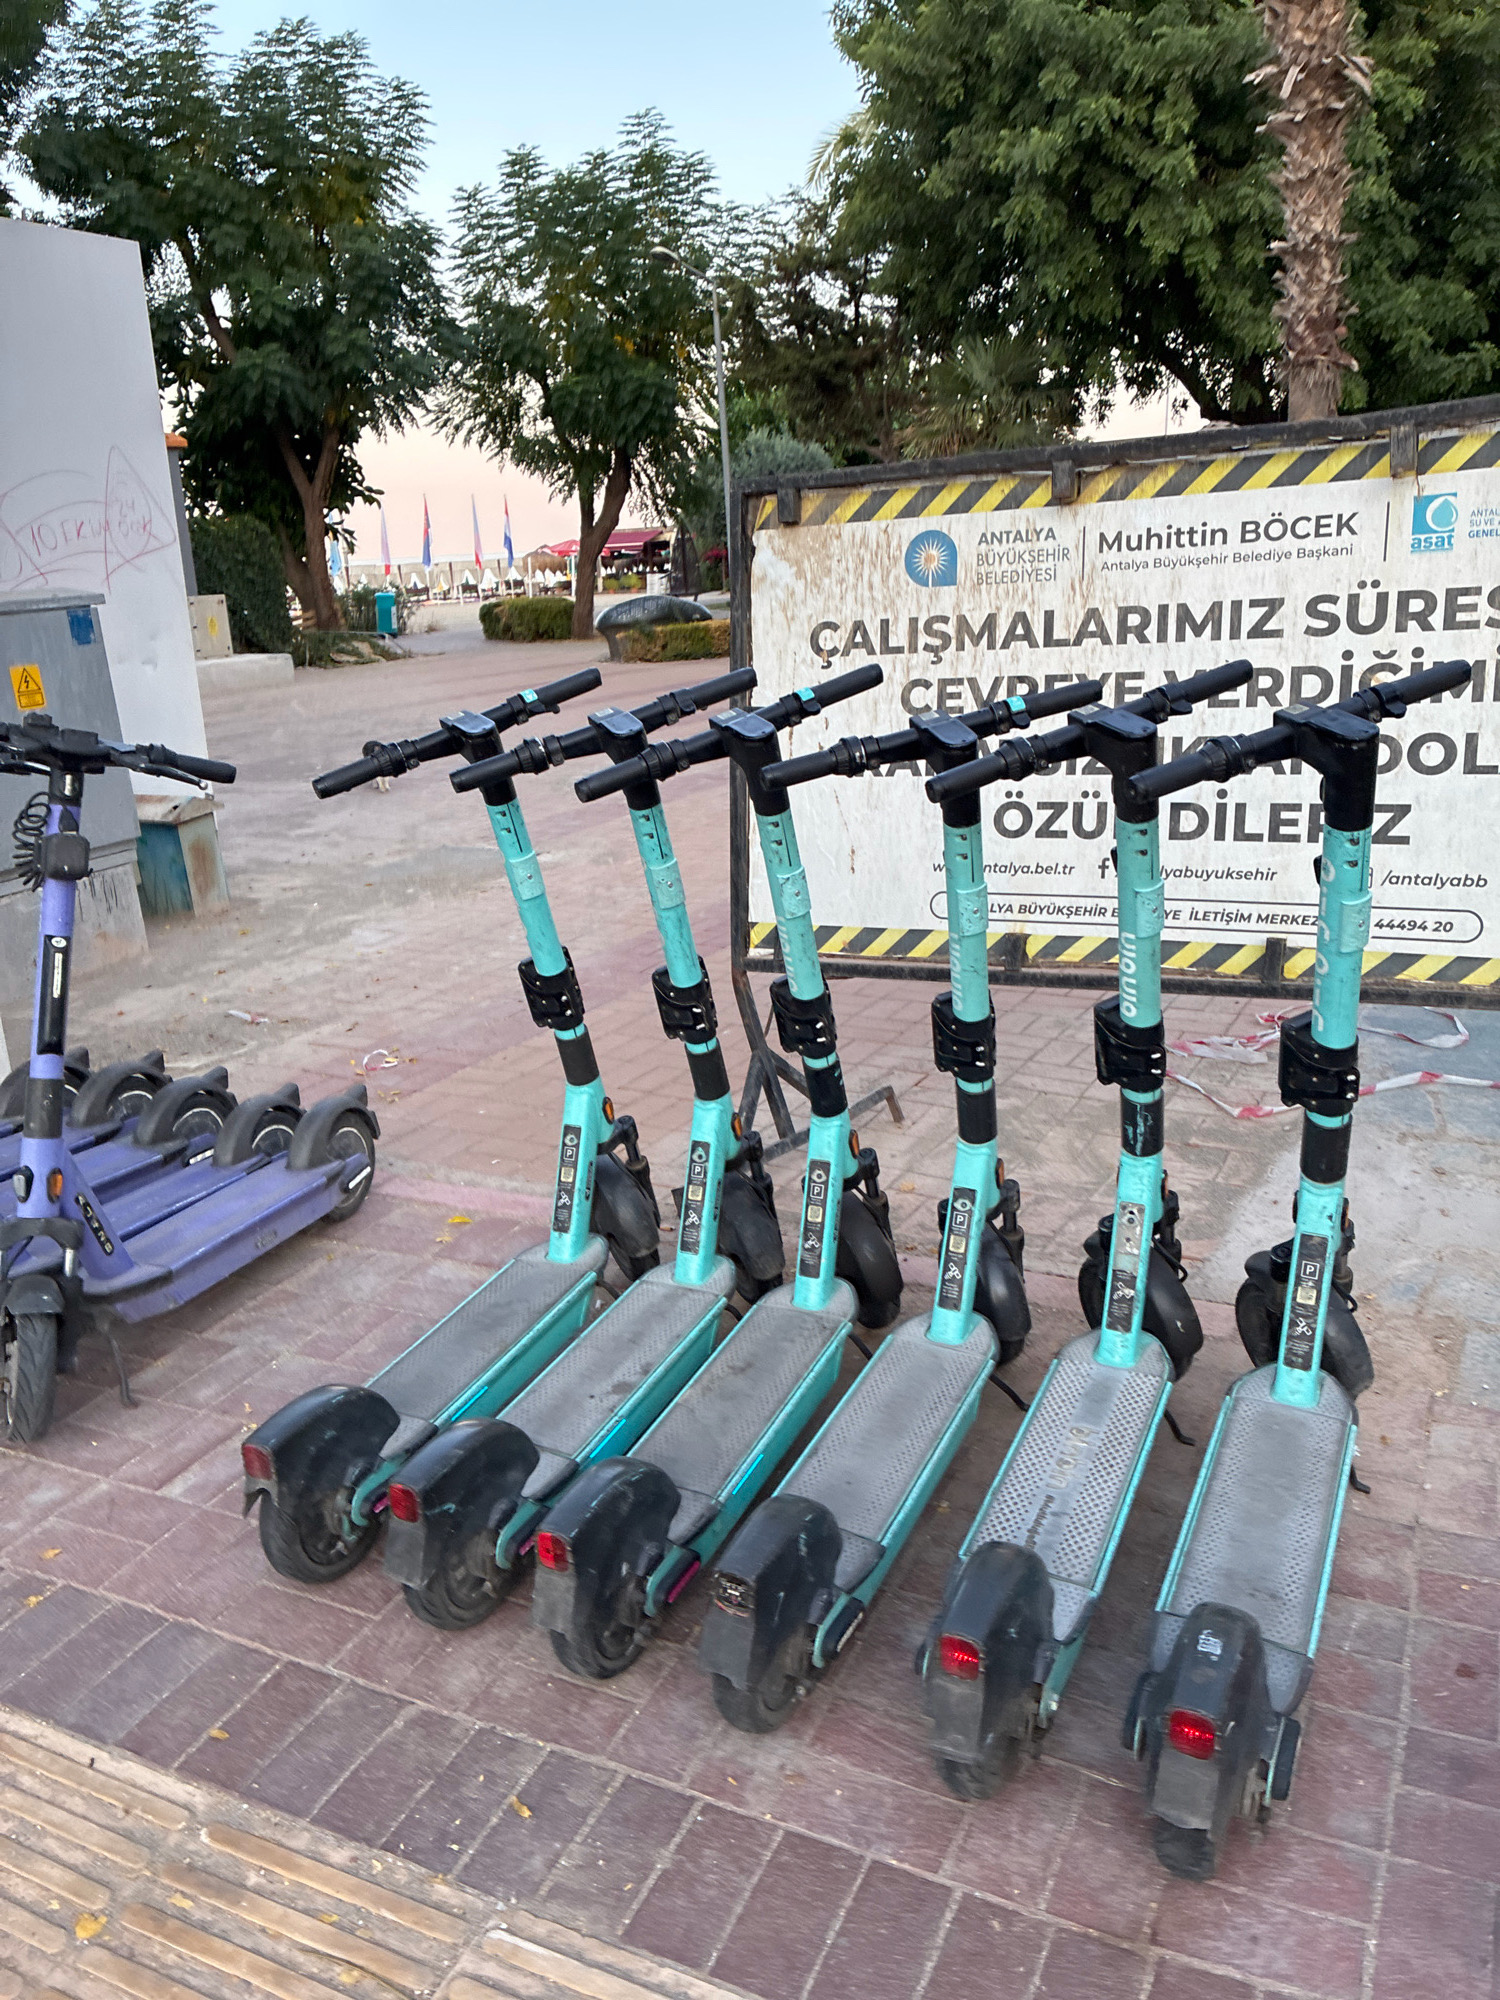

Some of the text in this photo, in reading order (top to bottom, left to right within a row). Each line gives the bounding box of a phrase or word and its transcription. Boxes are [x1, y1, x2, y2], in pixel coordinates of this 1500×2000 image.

[977, 527, 1057, 546] ANTALYA
[1098, 511, 1359, 554] Muhittin BÖCEK
[1410, 533, 1454, 549] asat
[1468, 528, 1500, 539] GENEL
[976, 544, 1070, 568] BÜYÜKŞEHİR
[1100, 560, 1149, 573] Antalya
[1153, 552, 1228, 570] Büyükşehir
[1232, 548, 1292, 563] Belediye
[976, 563, 1057, 585] BELEDİYESİ
[809, 597, 1286, 669] ÇALIŞMALARIMIZ
[1380, 869, 1488, 890] /antalyabb
[1018, 903, 1107, 919] BÜYÜKŞEHİR
[1189, 907, 1252, 926] İLETİŞİM
